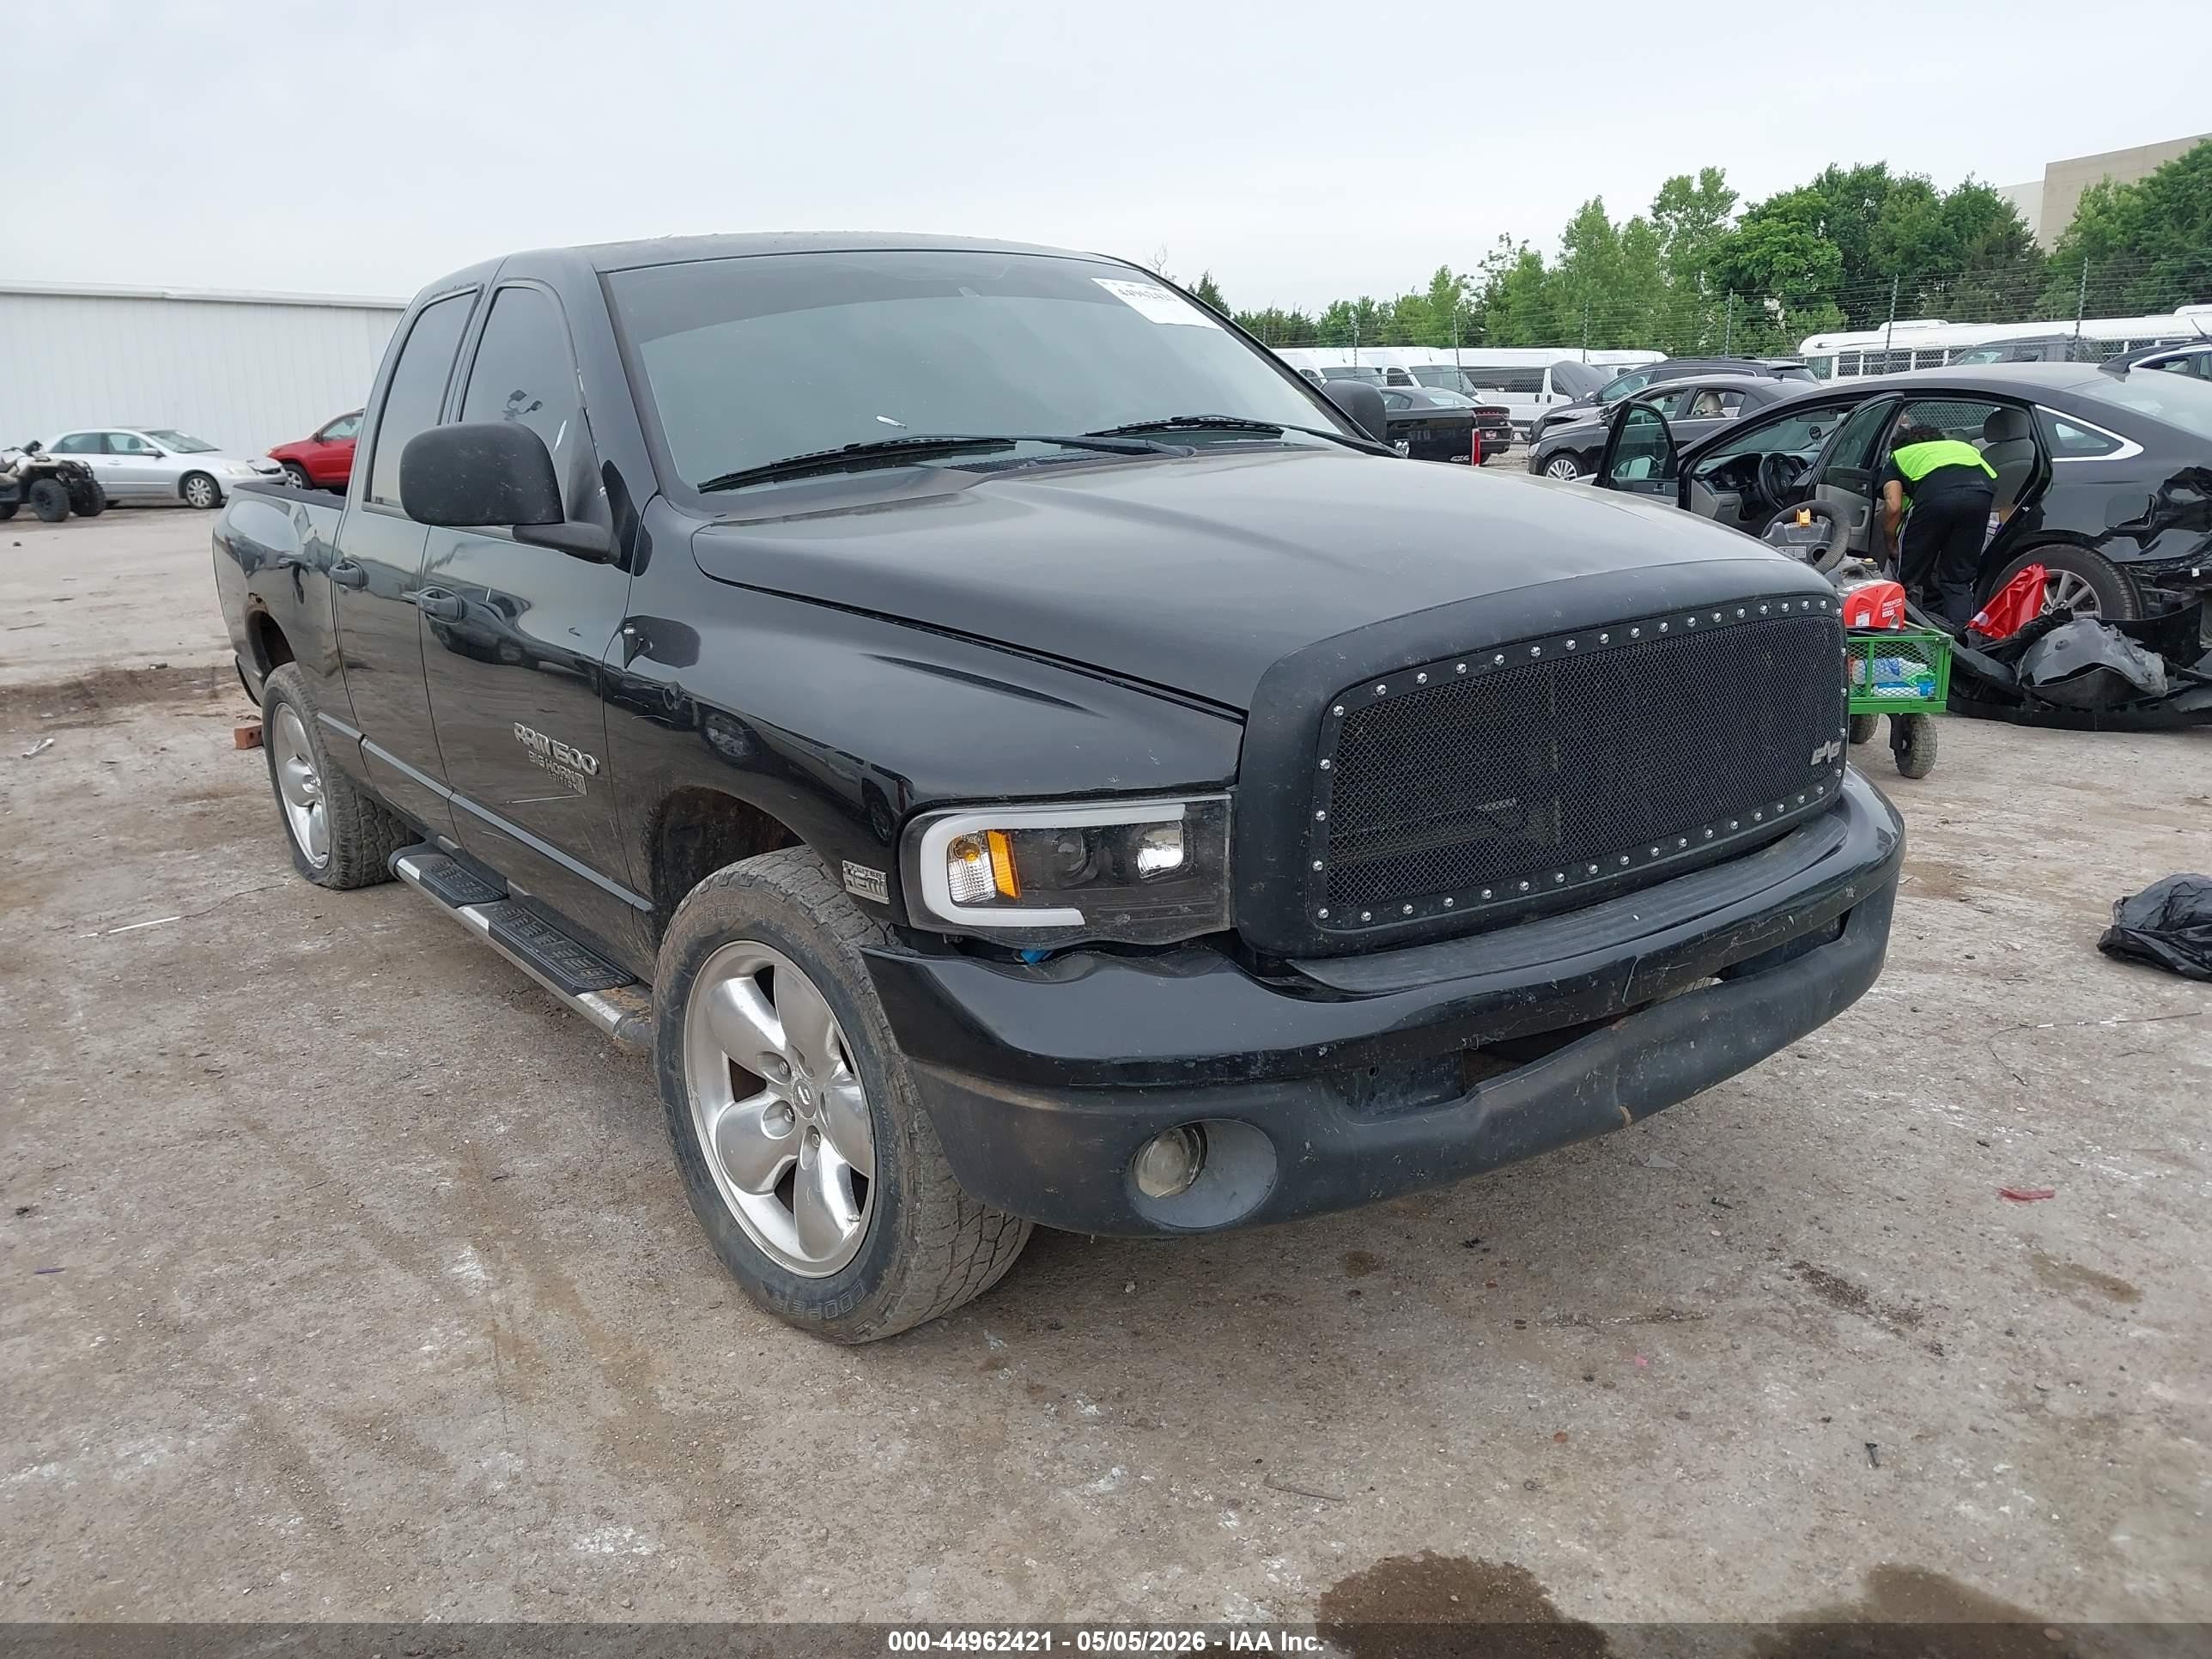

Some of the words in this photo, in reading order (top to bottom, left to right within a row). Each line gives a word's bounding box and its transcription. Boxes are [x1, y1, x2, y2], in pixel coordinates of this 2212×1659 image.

[514, 721, 551, 757] RAM
[551, 739, 599, 776] 1500
[842, 866, 888, 898] HEMI
[775, 1279, 866, 1321] COOPER
